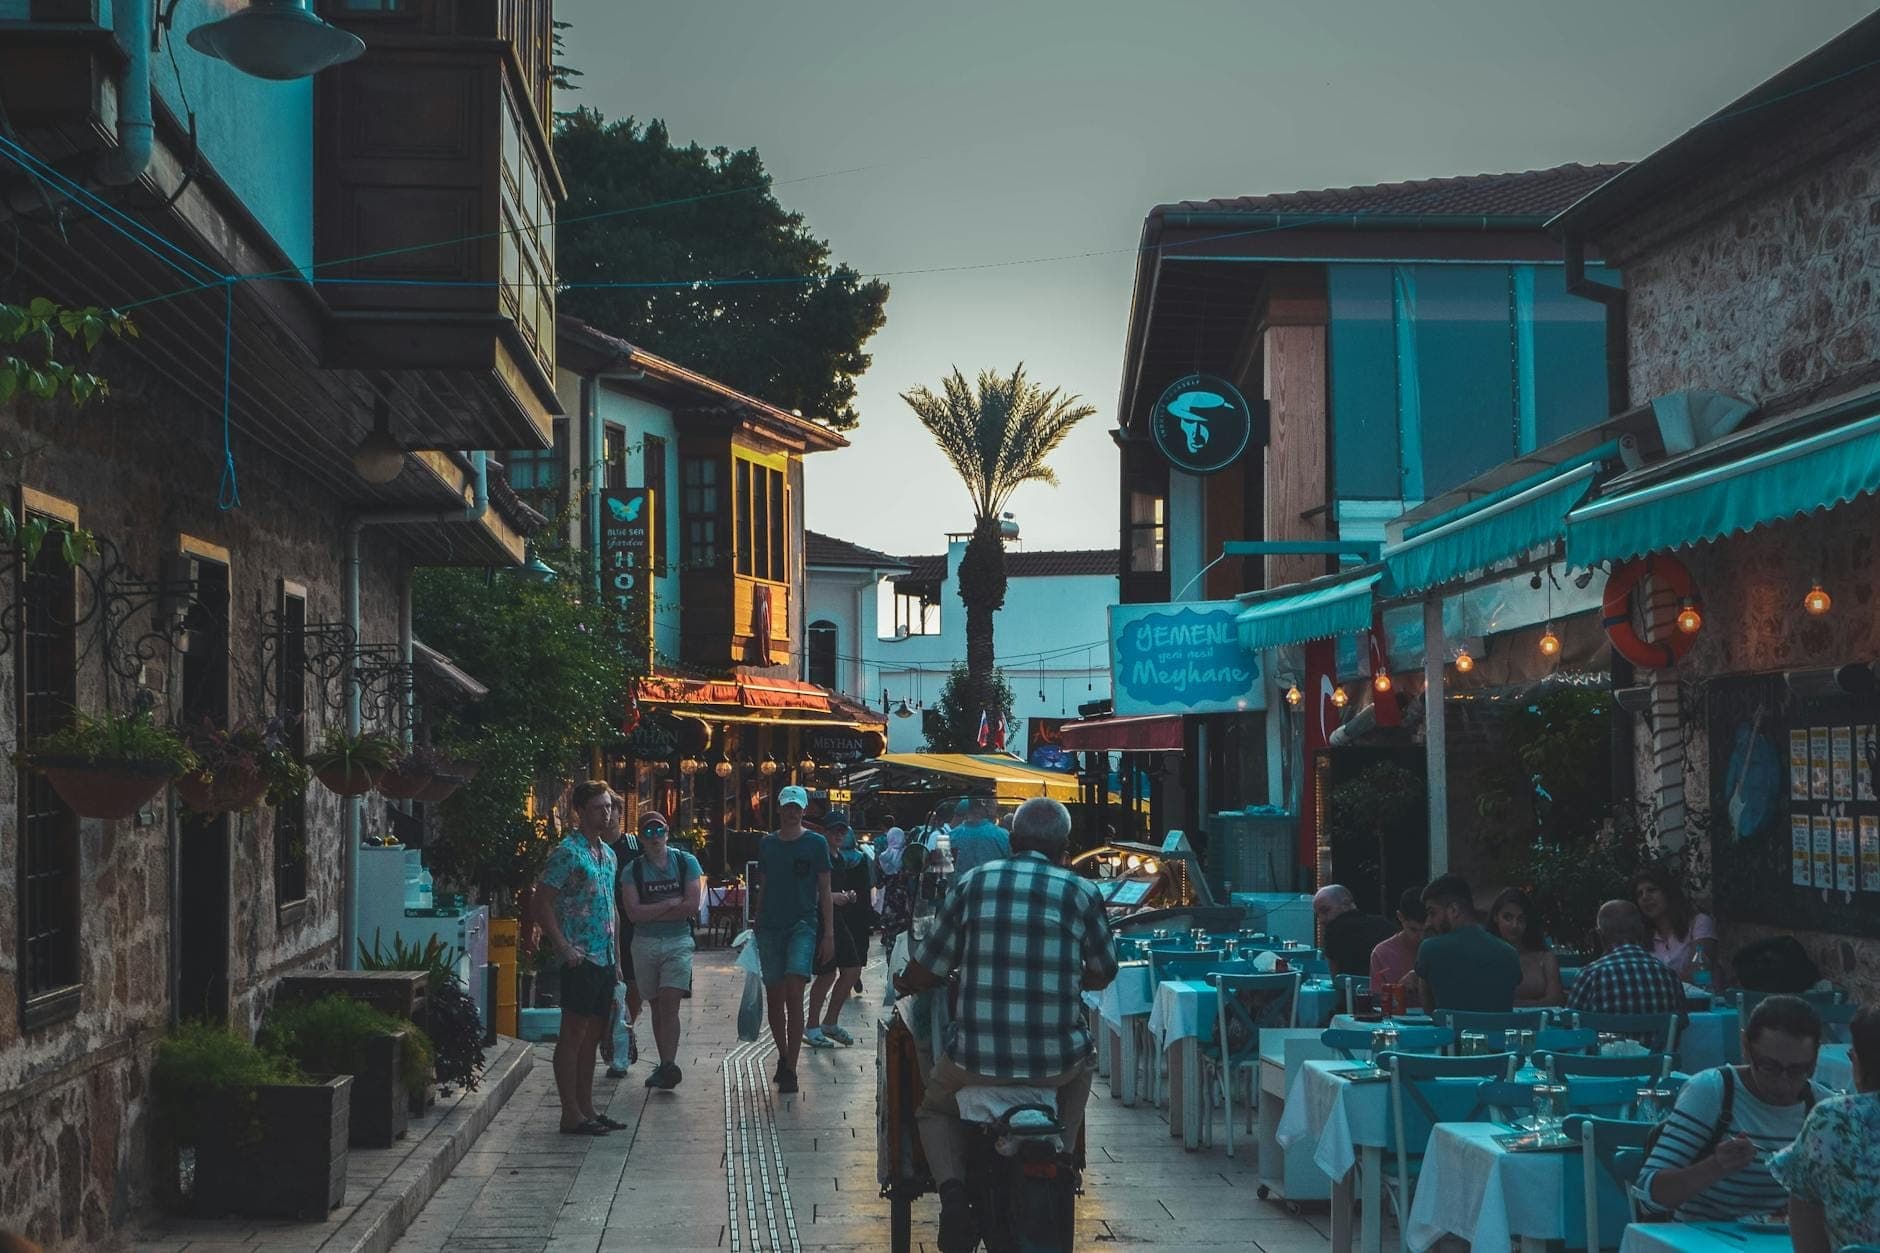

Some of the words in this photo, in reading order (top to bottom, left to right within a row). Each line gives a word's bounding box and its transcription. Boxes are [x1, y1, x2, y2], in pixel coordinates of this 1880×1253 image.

[628, 528, 644, 536] SEA
[607, 537, 644, 549] Garden
[1135, 622, 1238, 652] YEMENL
[1157, 651, 1183, 664] yeni
[1187, 647, 1214, 659] nesil
[1132, 659, 1250, 692] Meyhane
[813, 736, 863, 750] MEYHAN
